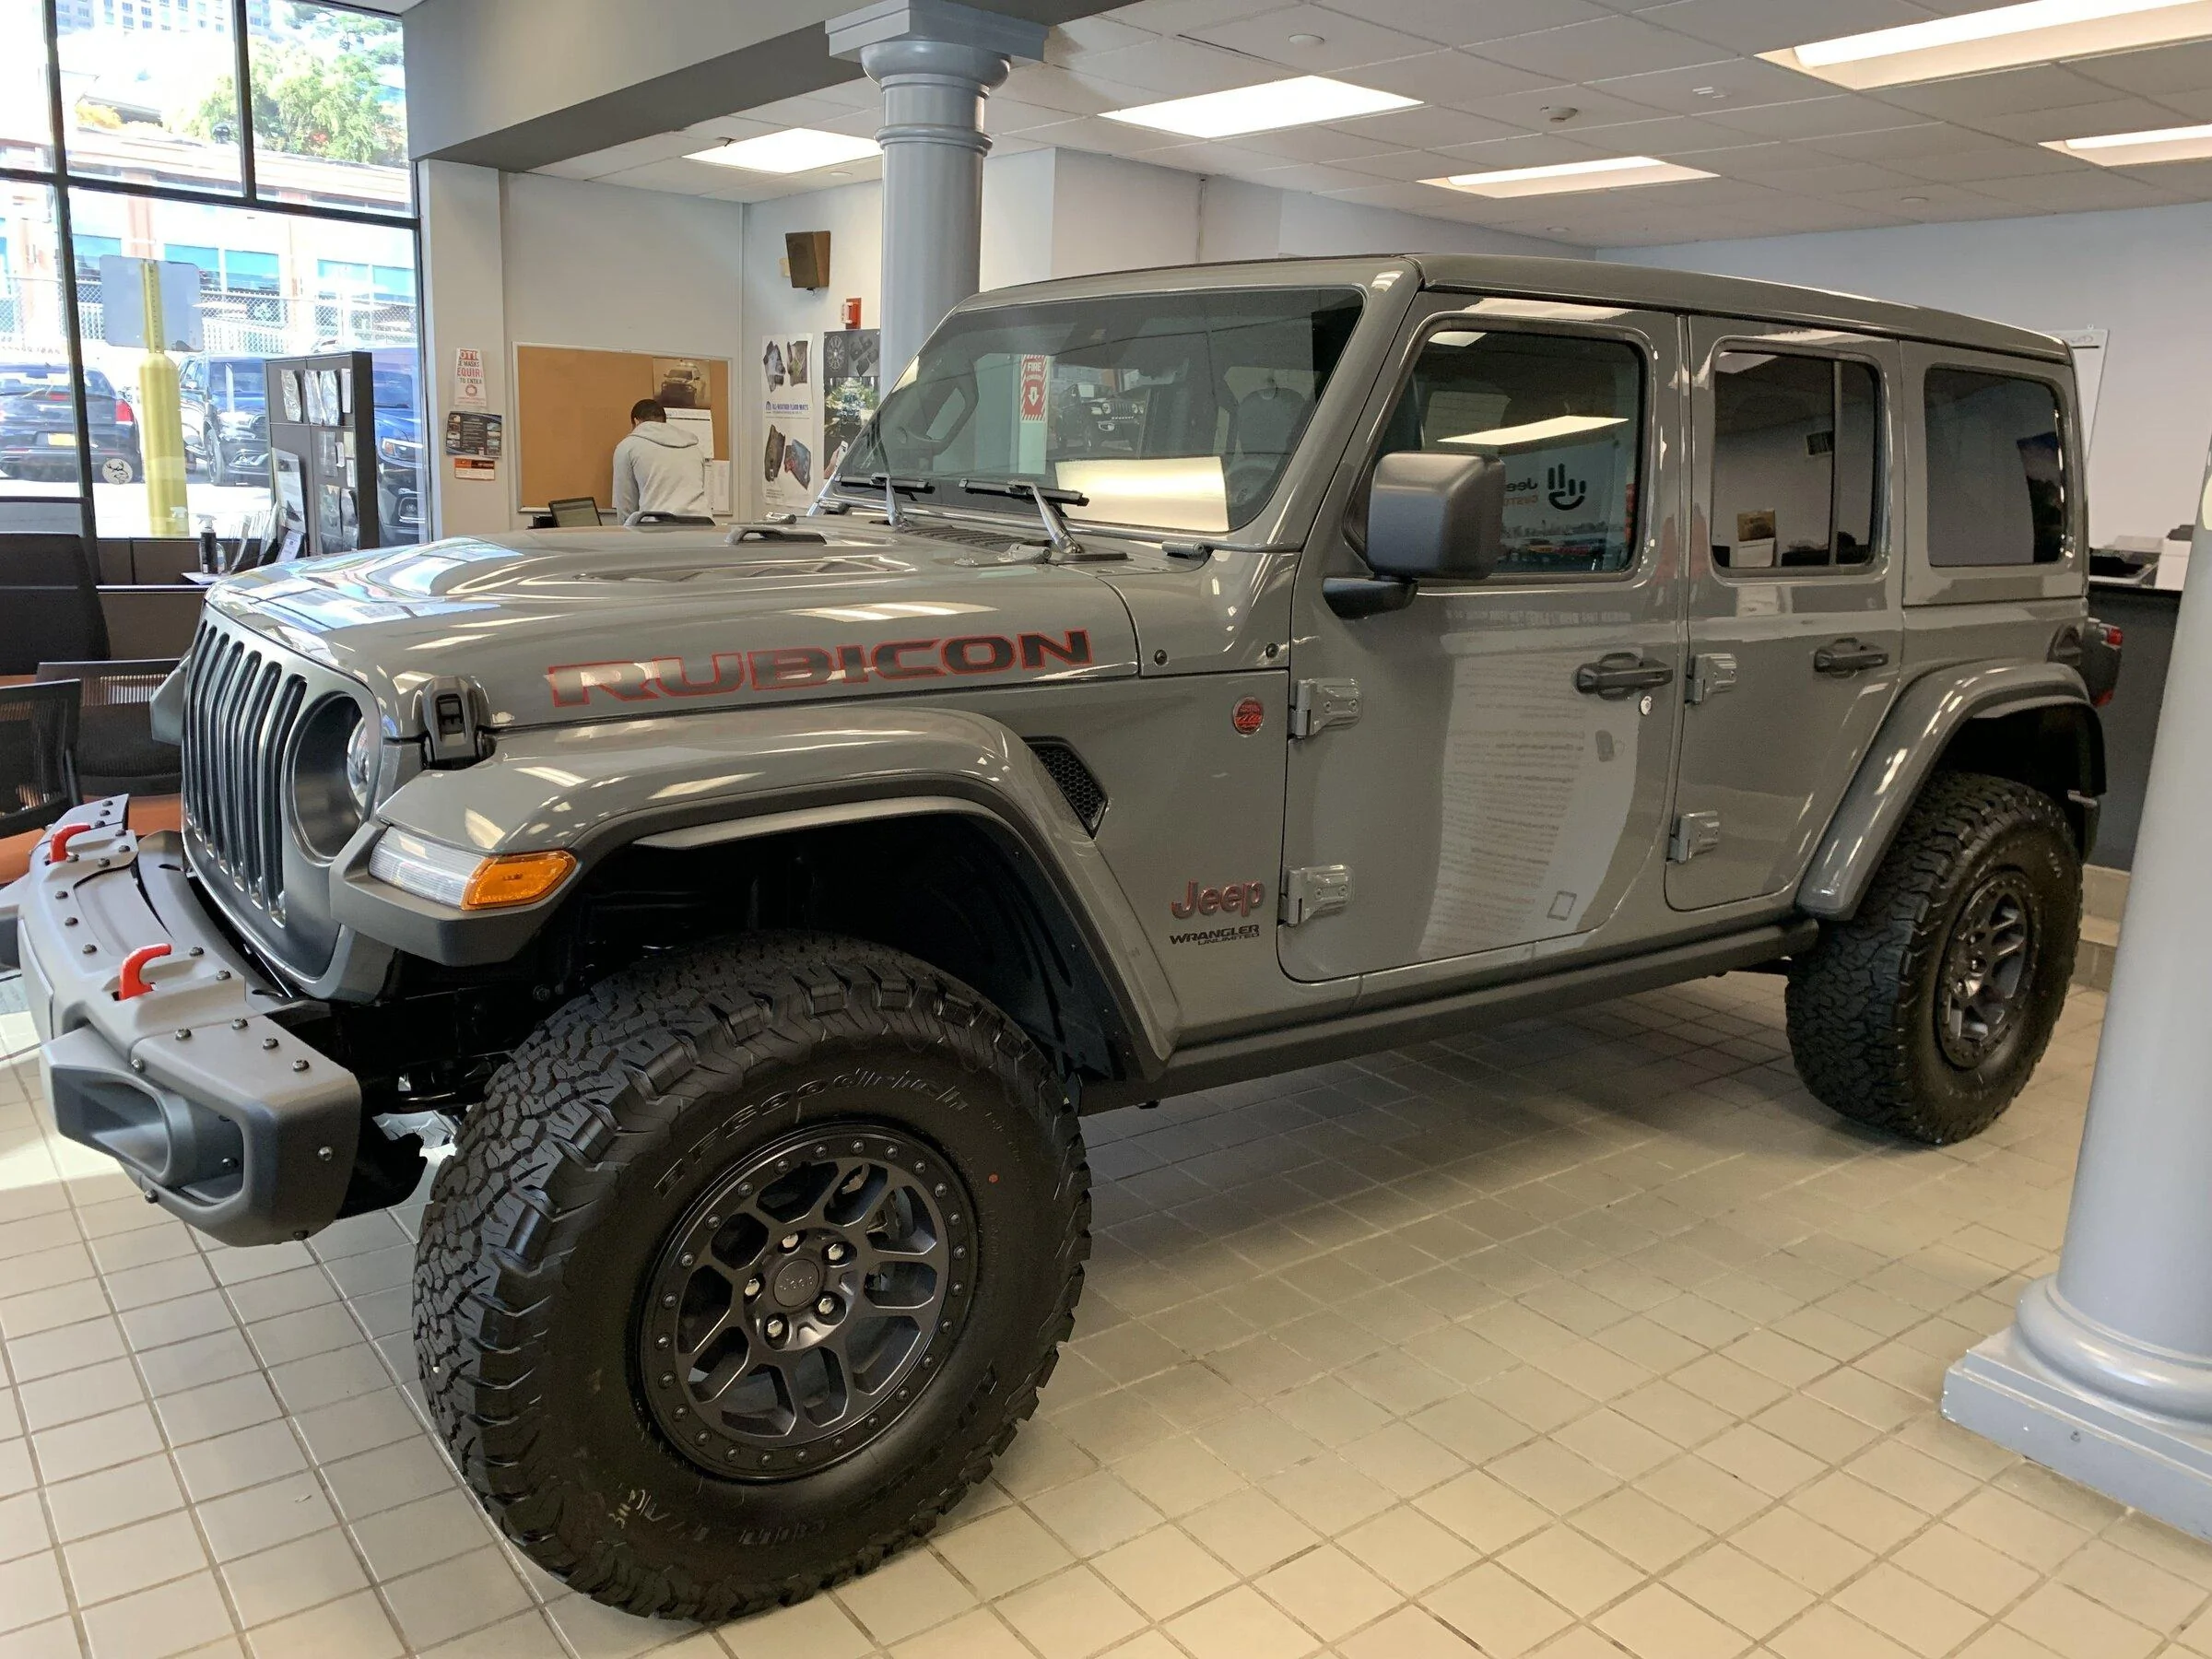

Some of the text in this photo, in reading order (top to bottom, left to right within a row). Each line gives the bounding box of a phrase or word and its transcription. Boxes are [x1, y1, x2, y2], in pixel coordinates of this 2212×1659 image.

[457, 368, 484, 378] EQUIR
[1027, 361, 1042, 372] FIRE
[546, 629, 1093, 708] RUBICON
[1171, 878, 1265, 920] Jeep
[1169, 924, 1260, 945] WRANGLER
[1197, 933, 1260, 946] UNLIMITED
